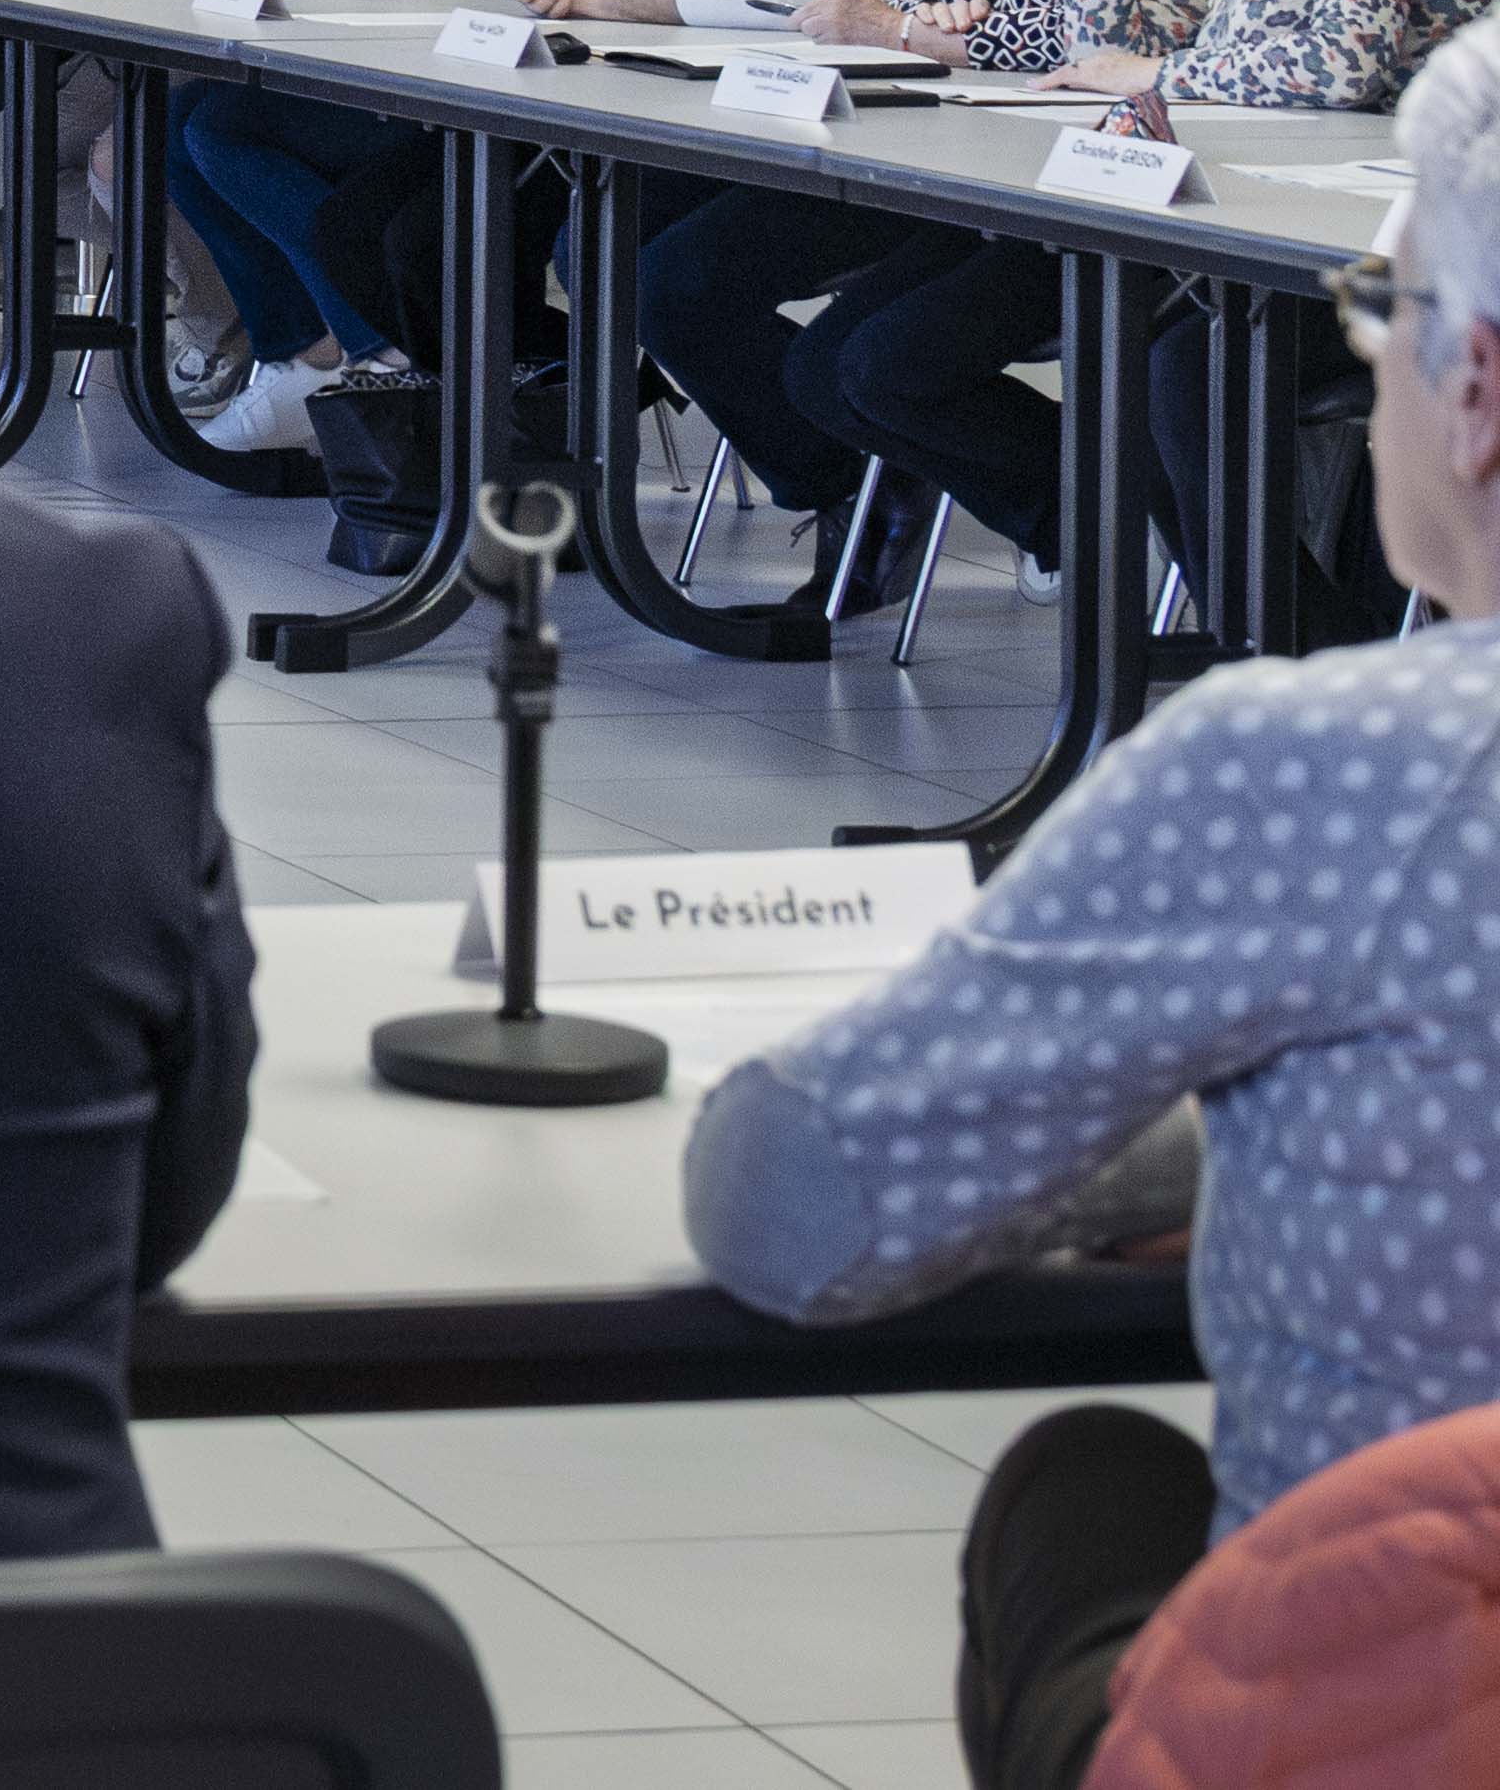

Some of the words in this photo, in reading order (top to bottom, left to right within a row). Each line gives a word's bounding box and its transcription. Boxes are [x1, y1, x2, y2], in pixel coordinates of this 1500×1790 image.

[1072, 139, 1118, 161] Christelle
[1120, 149, 1165, 170] GRISON
[579, 889, 637, 930] Le
[654, 884, 874, 928] Président
